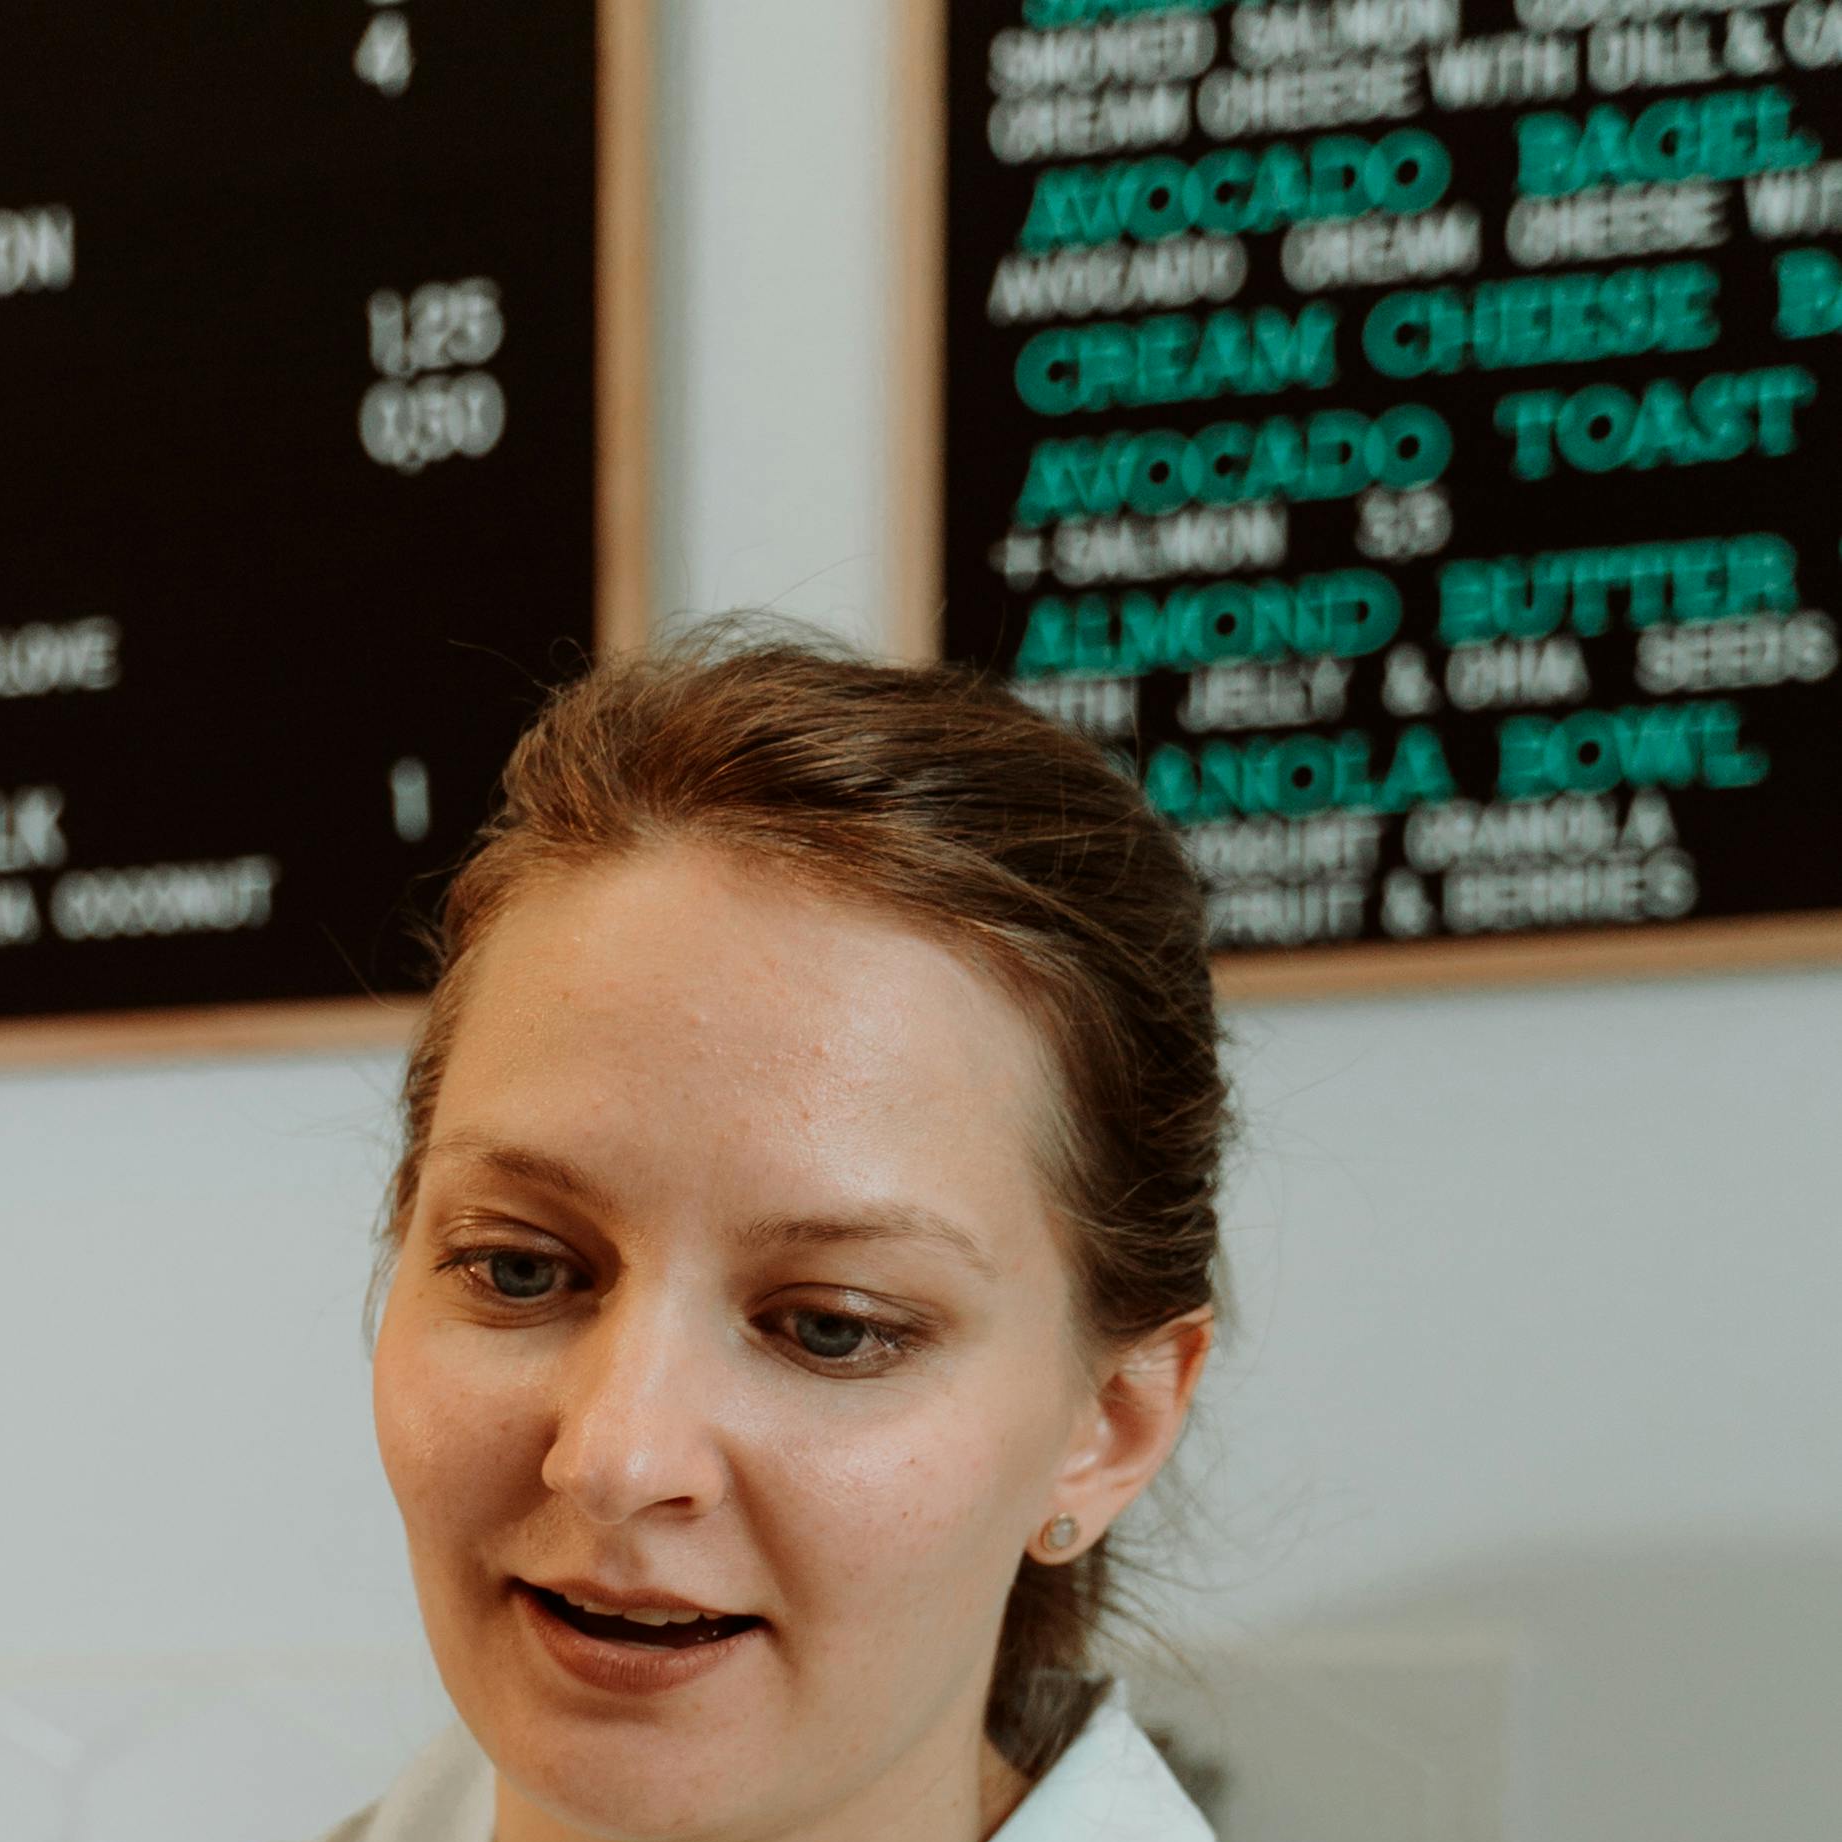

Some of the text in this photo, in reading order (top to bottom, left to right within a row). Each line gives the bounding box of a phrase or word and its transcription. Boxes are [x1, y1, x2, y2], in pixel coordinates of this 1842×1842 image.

[358, 14, 412, 94] 4
[989, 85, 1189, 162] CREAM
[1198, 58, 1422, 139] CHEESE
[1429, 35, 1578, 108] WITH
[1021, 86, 1820, 255] AVOCADO BAGEL
[1282, 207, 1480, 291] CREAM
[1506, 184, 1728, 268] CHEESE
[1016, 302, 1337, 414] CREAM
[1363, 261, 1719, 378] CHEESE
[1019, 366, 1816, 527] AVOCADO TOAST
[1054, 502, 1288, 585] SALMON
[1016, 534, 1797, 679] ALMOND BUTTER
[1497, 702, 1769, 796] BOWL
[53, 858, 278, 938] COCONUT
